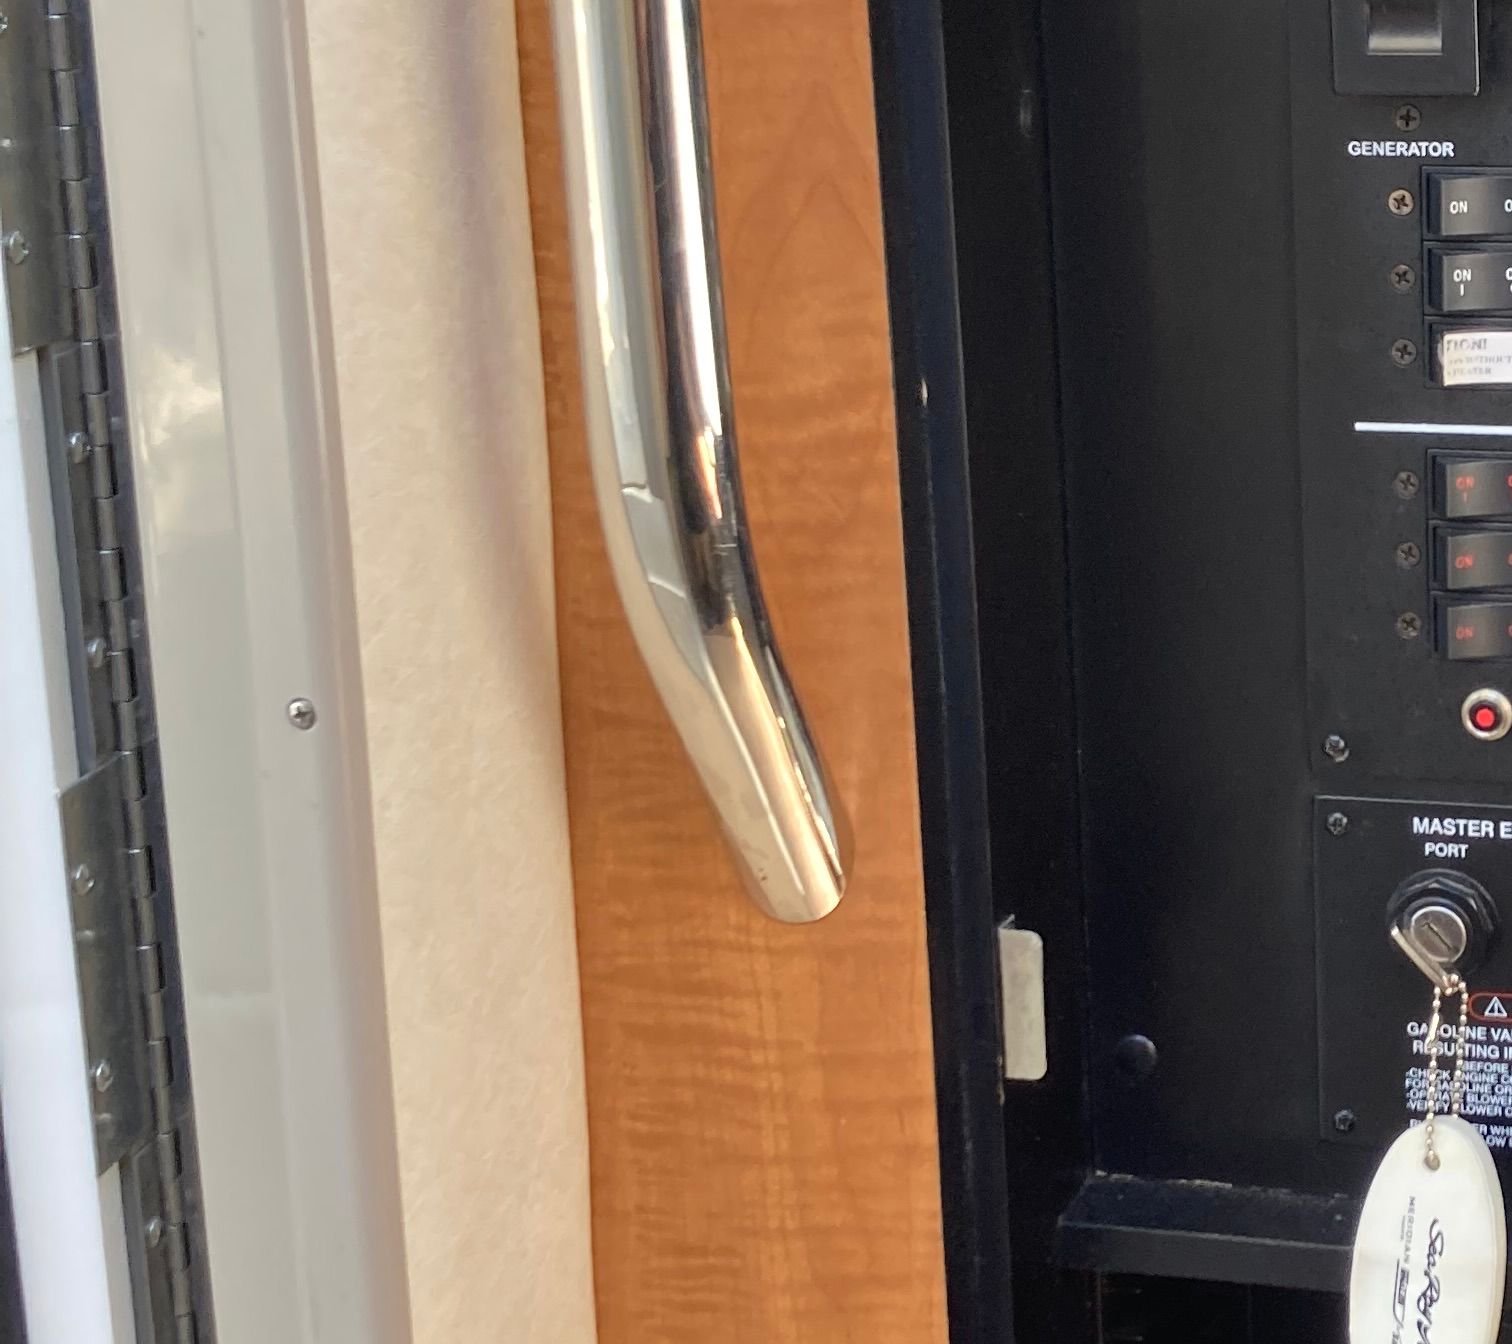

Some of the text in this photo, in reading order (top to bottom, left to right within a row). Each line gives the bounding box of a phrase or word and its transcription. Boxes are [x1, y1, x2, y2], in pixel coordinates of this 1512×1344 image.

[1348, 141, 1455, 157] GENERATOR
[1450, 201, 1468, 214] ON
[1453, 269, 1471, 282] ON
[1413, 817, 1495, 839] MASTER
[1425, 842, 1469, 858] PORT
